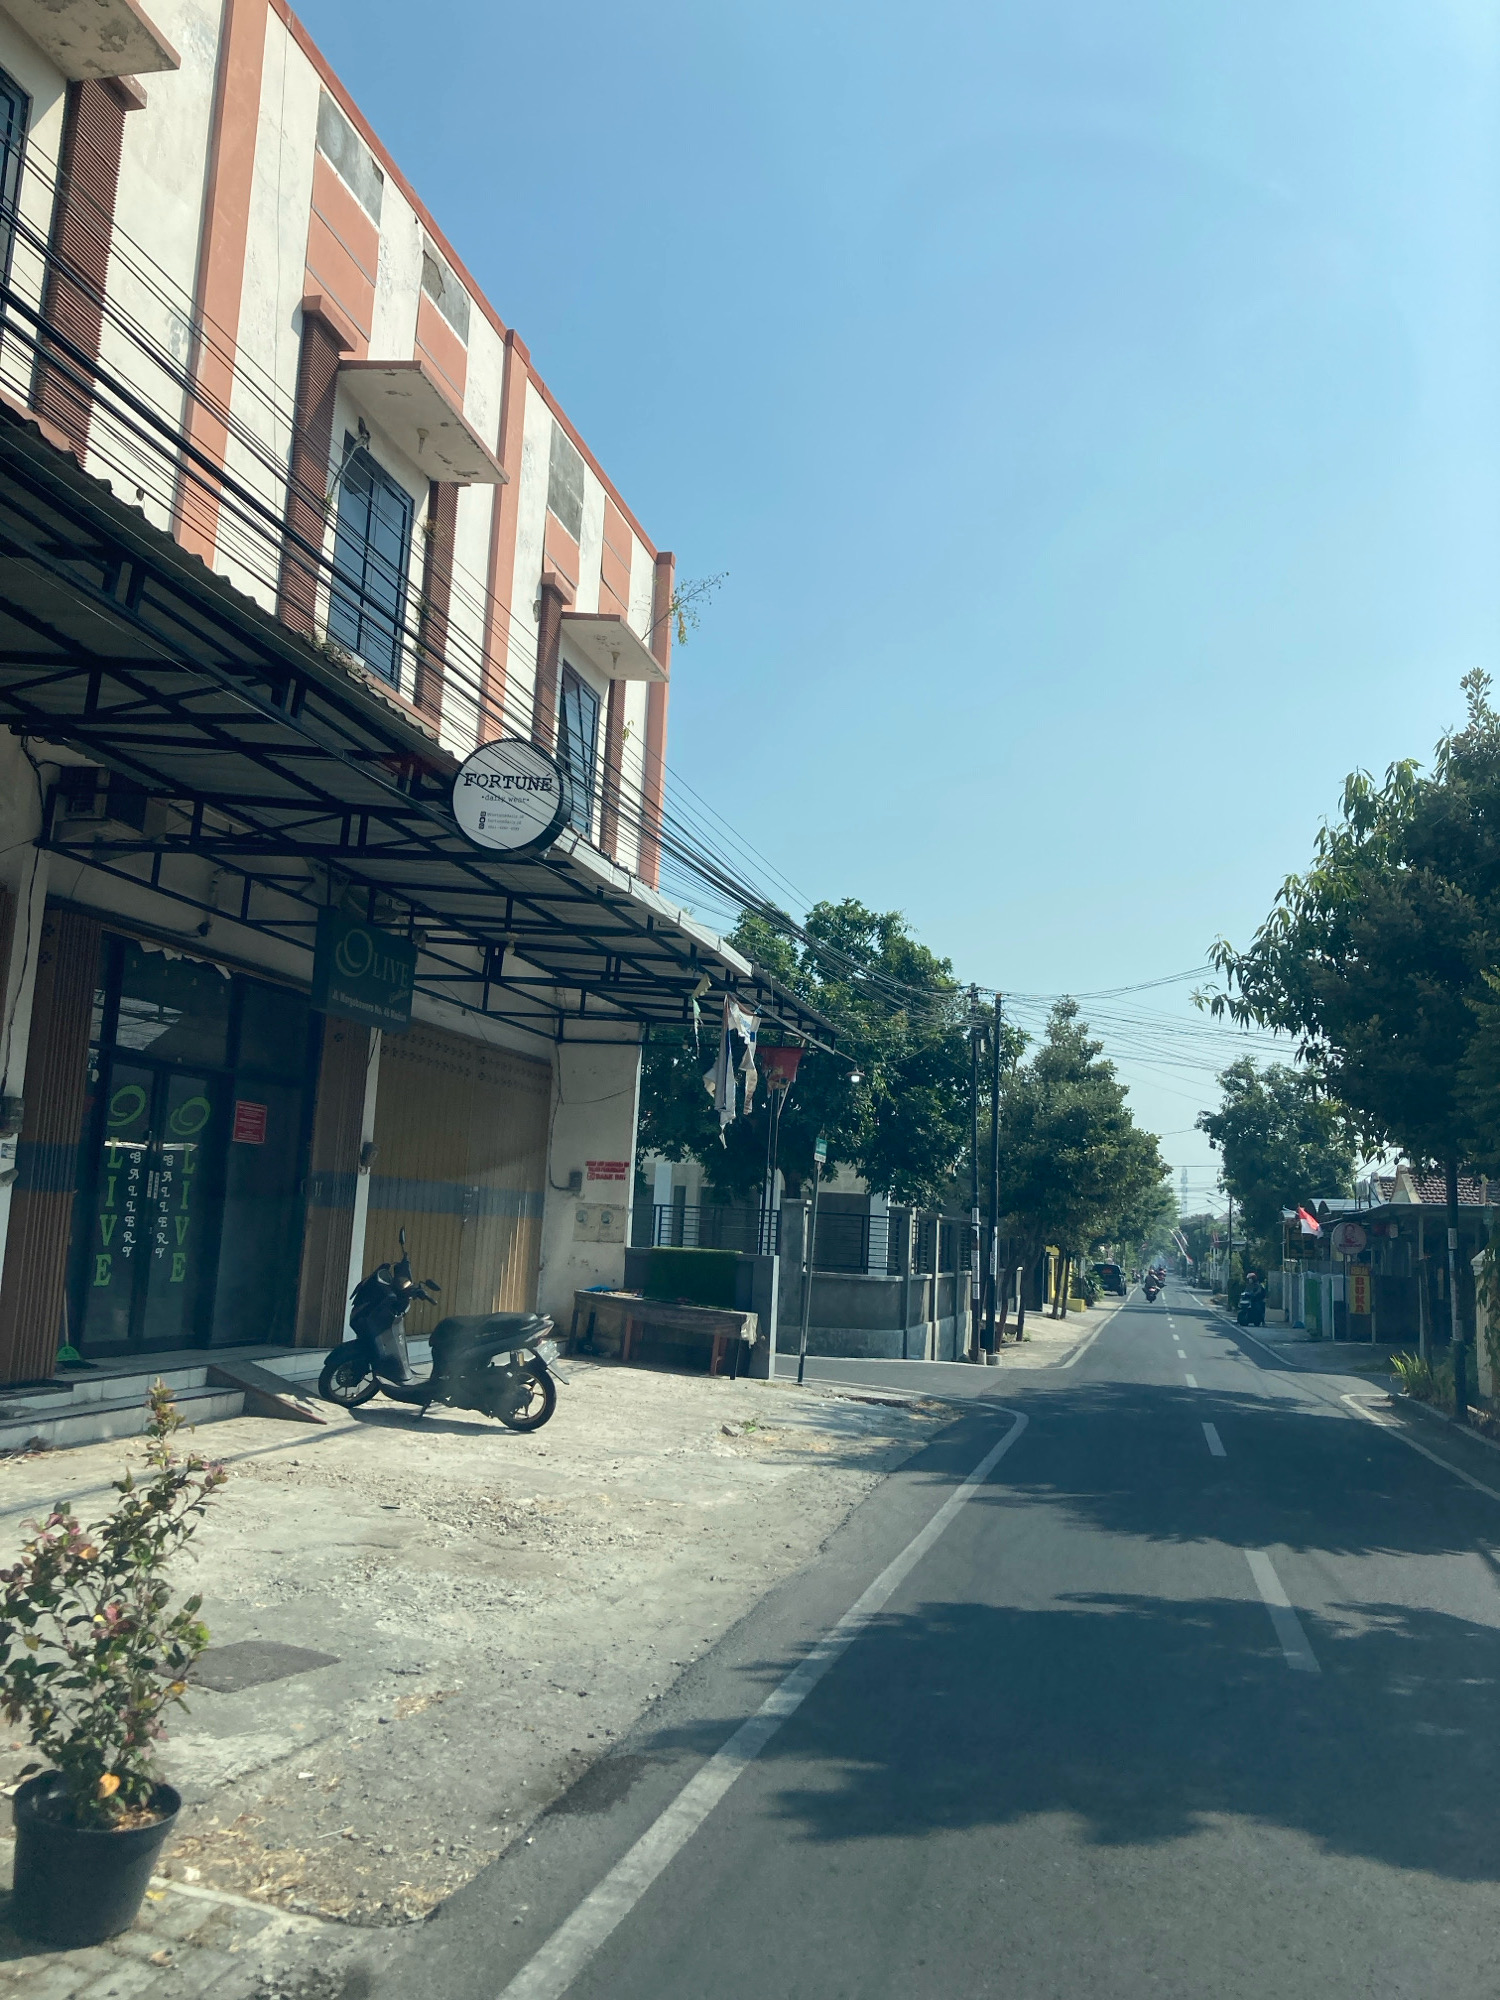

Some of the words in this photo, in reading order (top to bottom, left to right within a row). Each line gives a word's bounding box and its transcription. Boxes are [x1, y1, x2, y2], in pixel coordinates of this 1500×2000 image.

[335, 928, 410, 988] OLIVE
[122, 1151, 143, 1258] GALLERY
[155, 1154, 174, 1258] GALLERY
